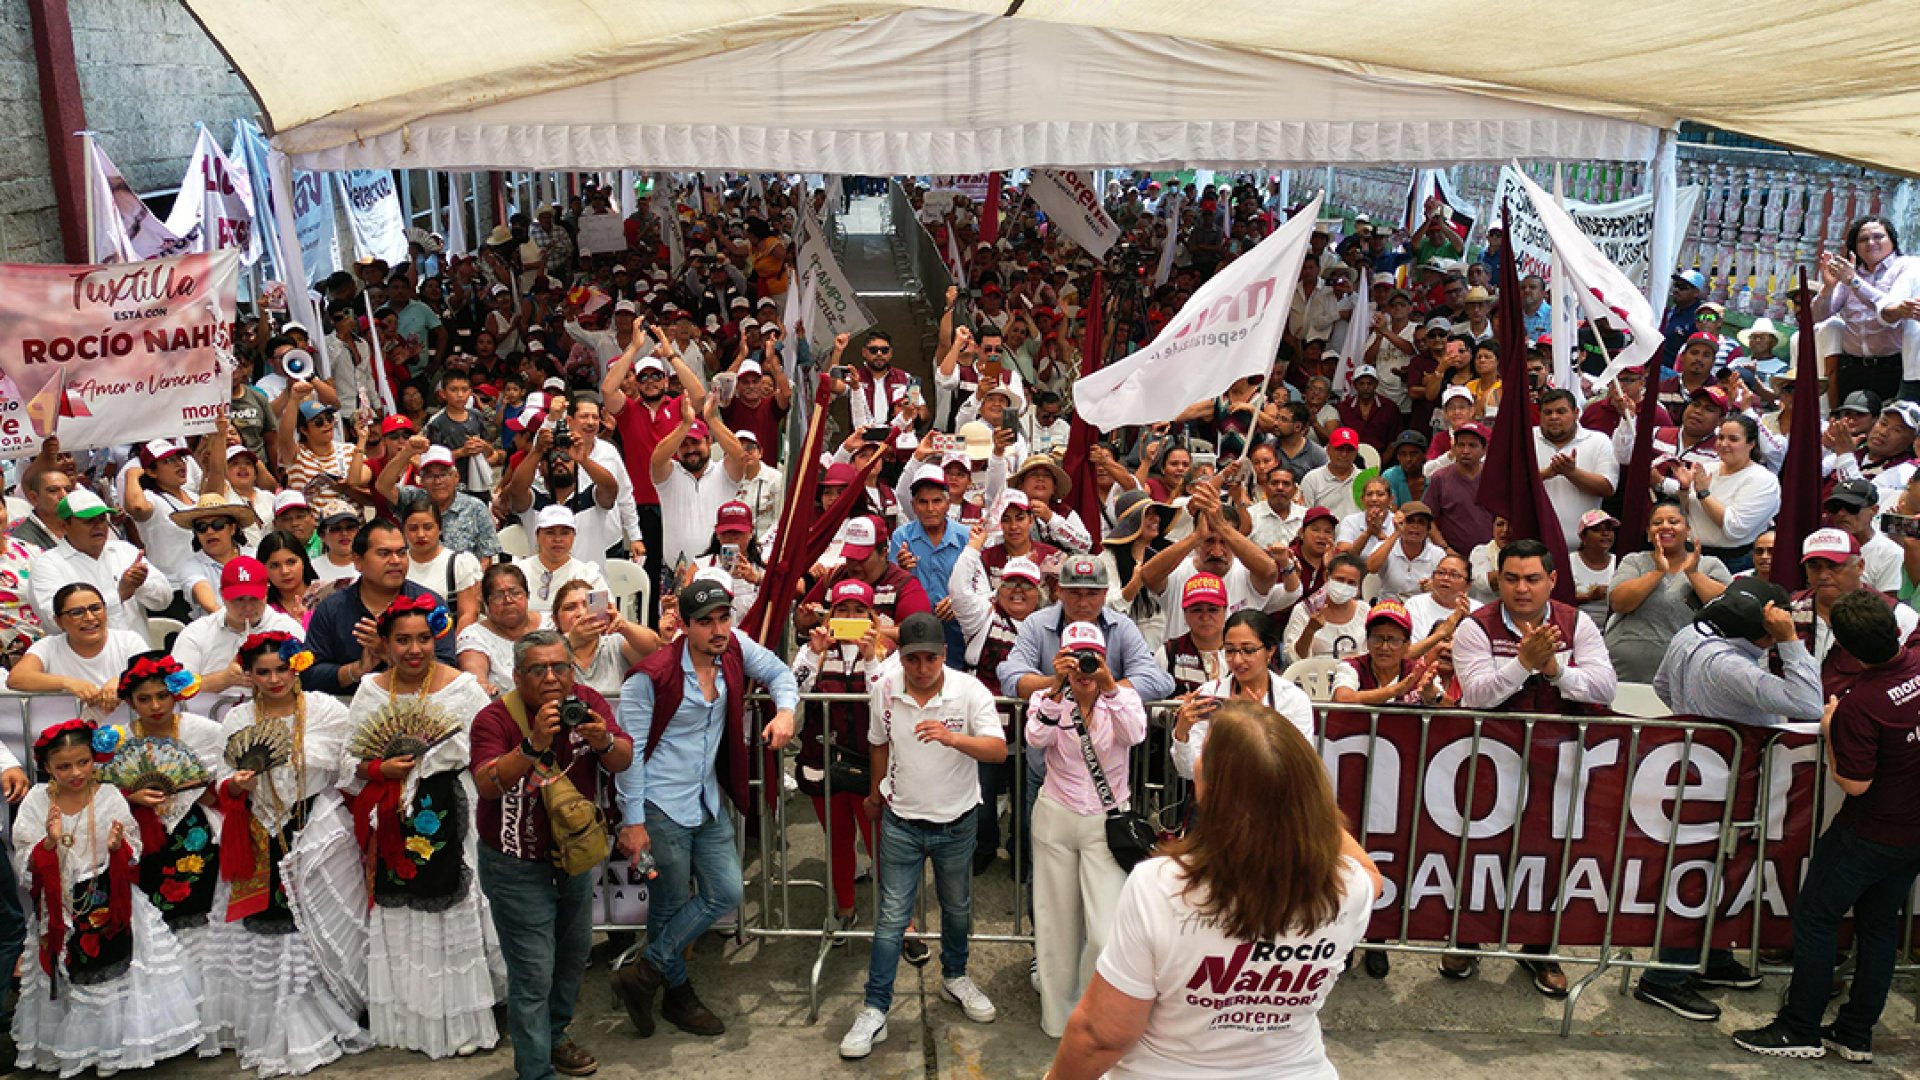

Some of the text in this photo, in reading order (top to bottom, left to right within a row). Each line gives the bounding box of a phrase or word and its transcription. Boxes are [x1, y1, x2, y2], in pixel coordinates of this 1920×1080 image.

[69, 264, 196, 311] Tuxtilla
[113, 307, 167, 321] ESTÁ CON
[22, 327, 133, 364] ROCÍO
[1186, 940, 1328, 994] Nahle
[1211, 1010, 1291, 1024] morena
